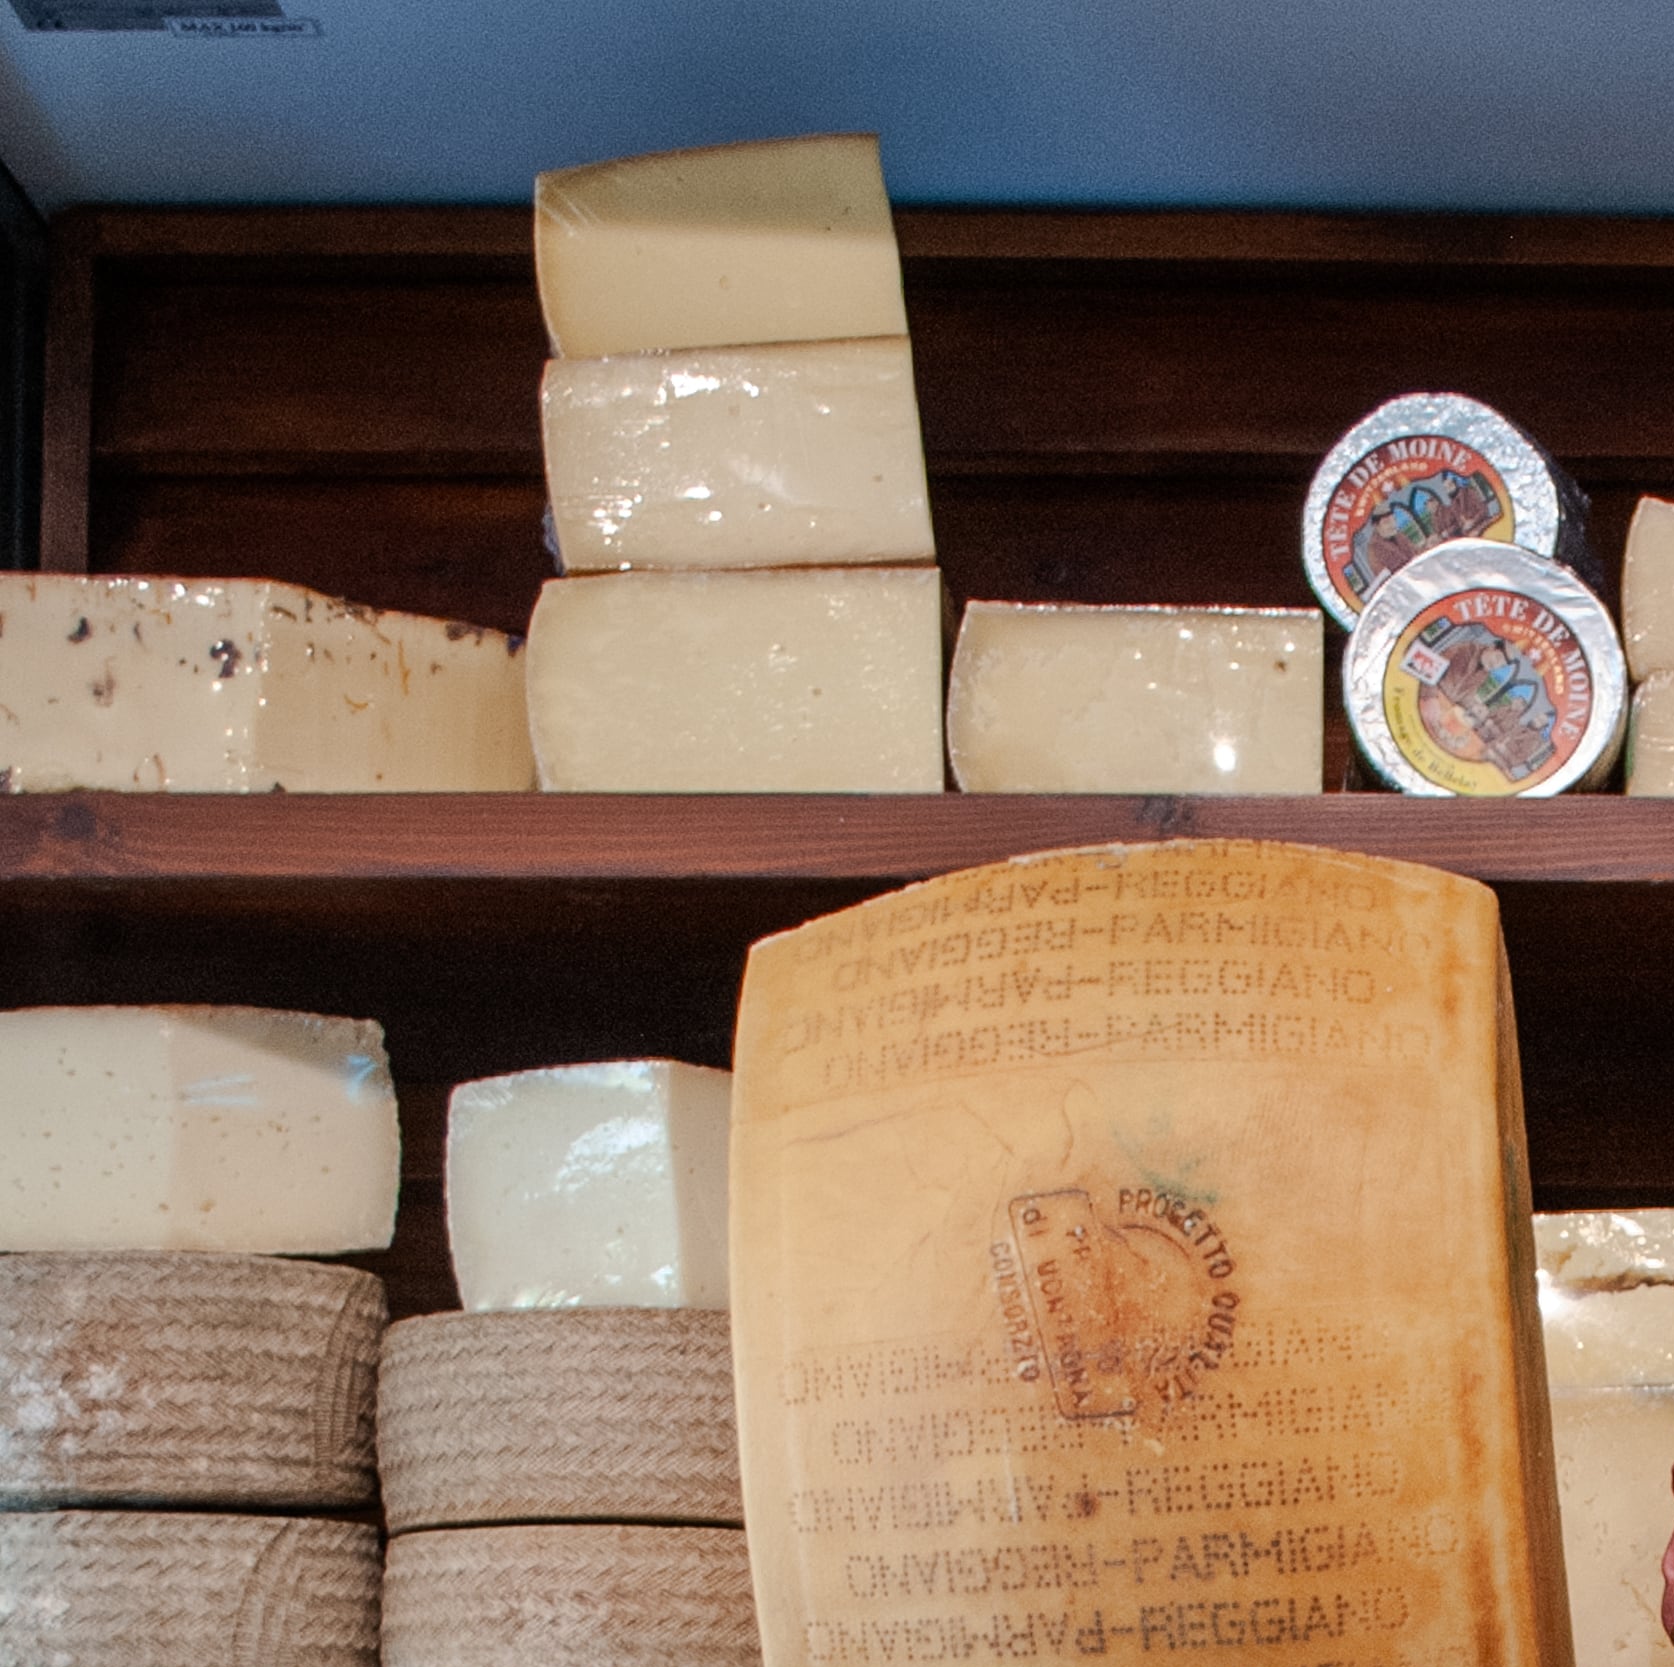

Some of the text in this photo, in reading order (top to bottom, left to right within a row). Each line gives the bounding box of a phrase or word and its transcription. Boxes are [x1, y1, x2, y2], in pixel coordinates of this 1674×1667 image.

[1347, 451, 1385, 490] DE
[1386, 437, 1473, 472] MOINE
[1531, 608, 1571, 649] DE
[1558, 648, 1590, 741] MOINE
